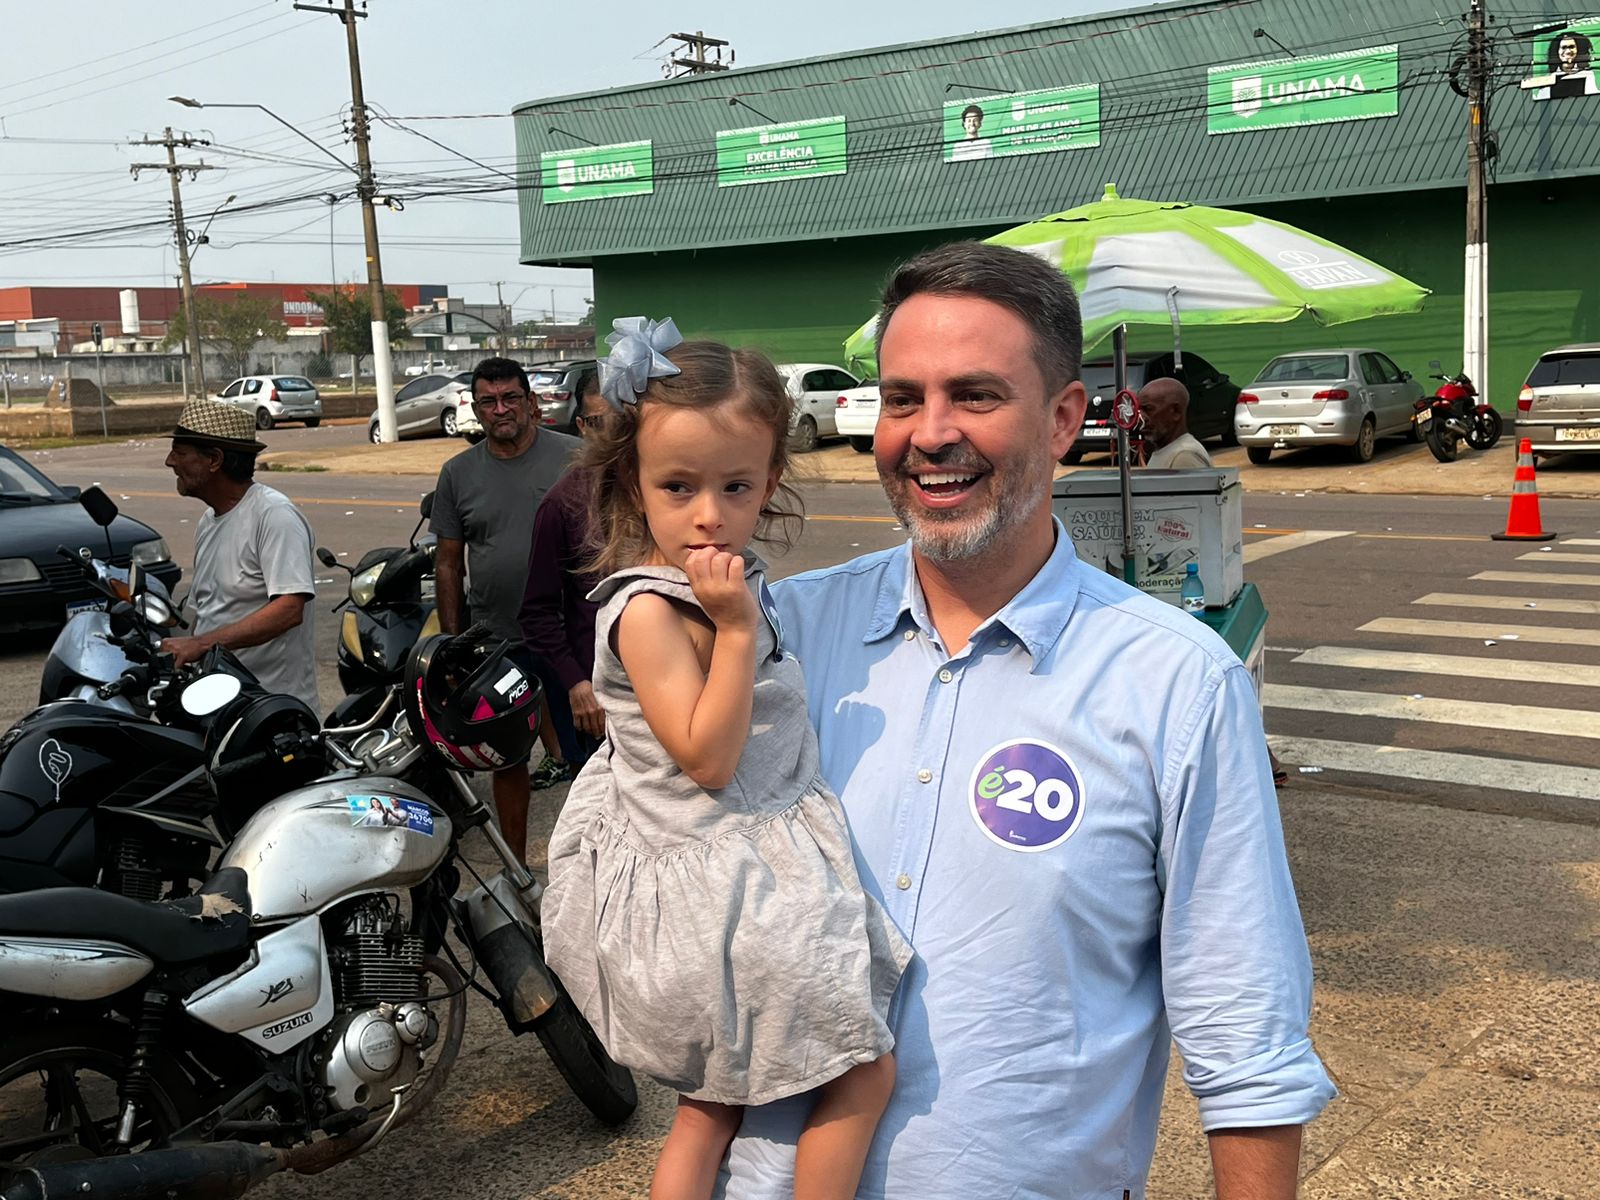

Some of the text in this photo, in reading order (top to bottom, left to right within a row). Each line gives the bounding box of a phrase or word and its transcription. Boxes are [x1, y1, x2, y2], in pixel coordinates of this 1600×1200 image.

[1268, 74, 1365, 104] UNAMA
[1027, 101, 1069, 115] UNAMA
[769, 131, 799, 142] UNAMA
[746, 146, 814, 164] EXCELÊNCIA
[578, 161, 636, 182] UNAMA
[1289, 264, 1369, 286] HAVAN
[1072, 510, 1116, 524] AQUI
[263, 1013, 313, 1039] SUZUKI
